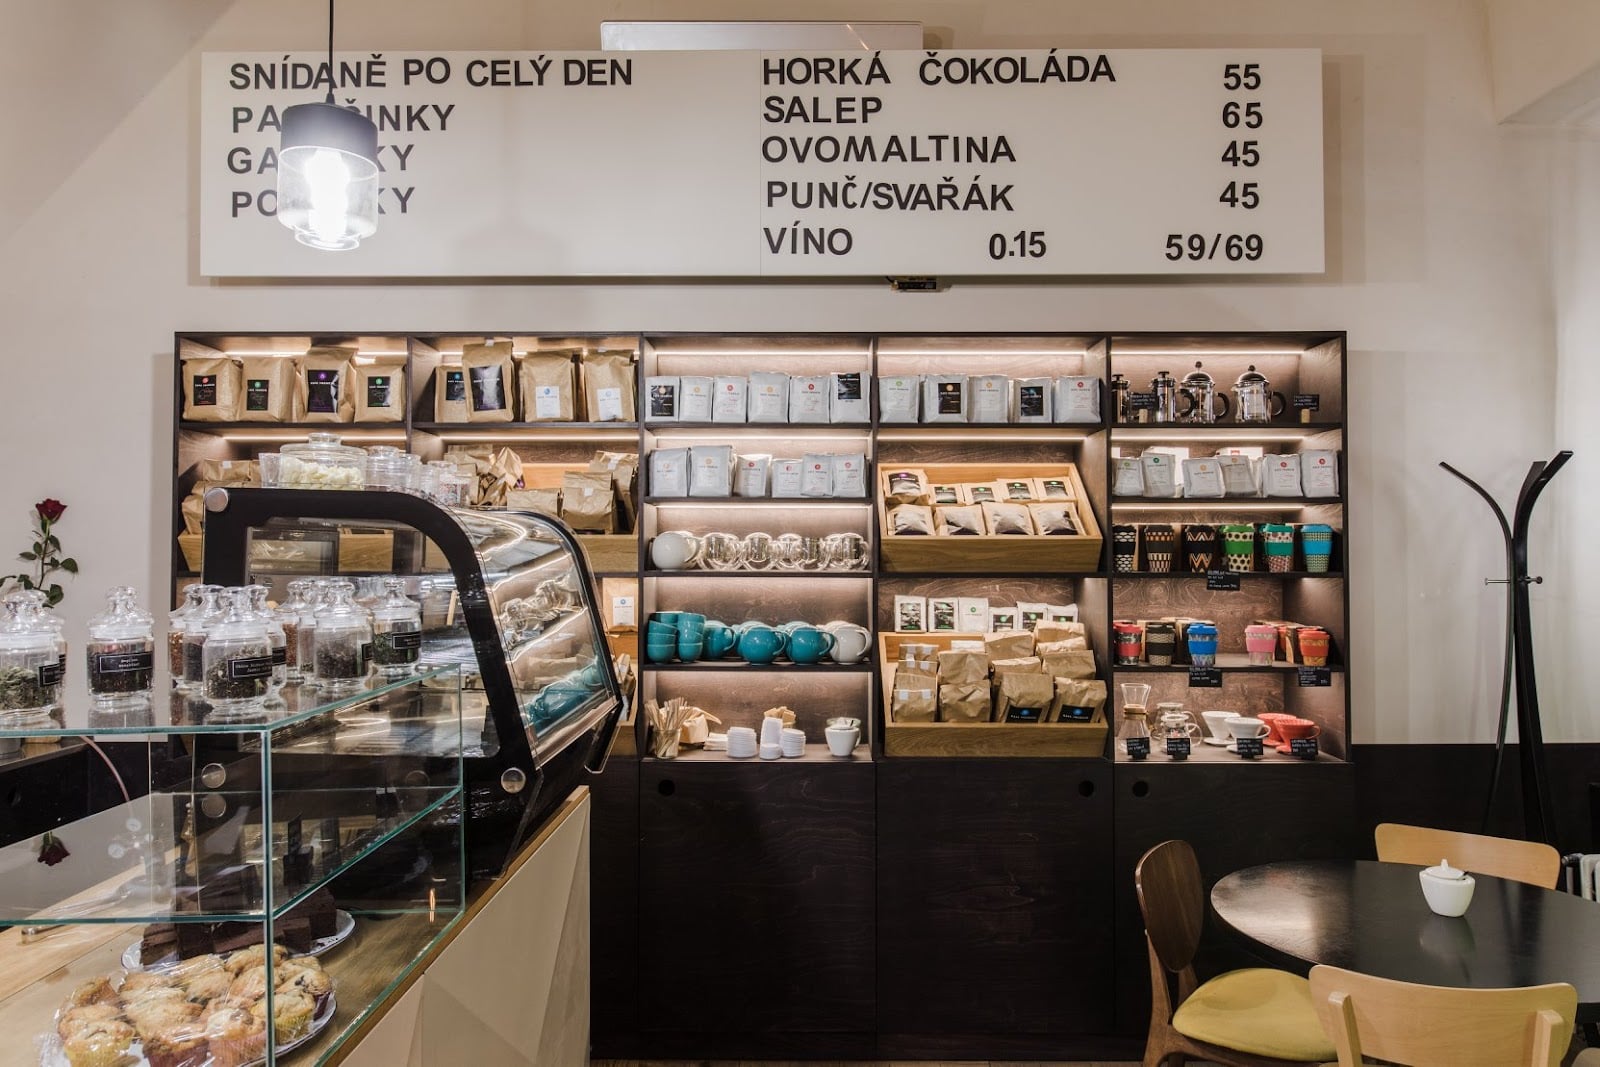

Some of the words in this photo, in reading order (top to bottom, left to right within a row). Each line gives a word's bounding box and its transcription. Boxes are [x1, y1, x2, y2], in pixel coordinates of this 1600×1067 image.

[229, 53, 387, 91] SNÍDANĚ
[403, 57, 452, 87] PO
[465, 54, 554, 88] CELÝ
[563, 58, 633, 88] DEN
[762, 50, 892, 86] HORKÁ
[918, 49, 1117, 86] ČOKOLÁDA
[1223, 63, 1262, 91] 55
[232, 98, 456, 134] PAINKY
[763, 95, 883, 124] SALEP
[1222, 101, 1264, 130] 65
[761, 134, 1017, 164] OVOMALTINA
[1221, 139, 1260, 168] 45
[766, 174, 1014, 212] PUNČ/SVAŘÁK
[1219, 181, 1260, 210] 45
[763, 220, 854, 256] VÍNO
[988, 230, 1047, 261] 0.15
[1165, 233, 1264, 262] 59/69
